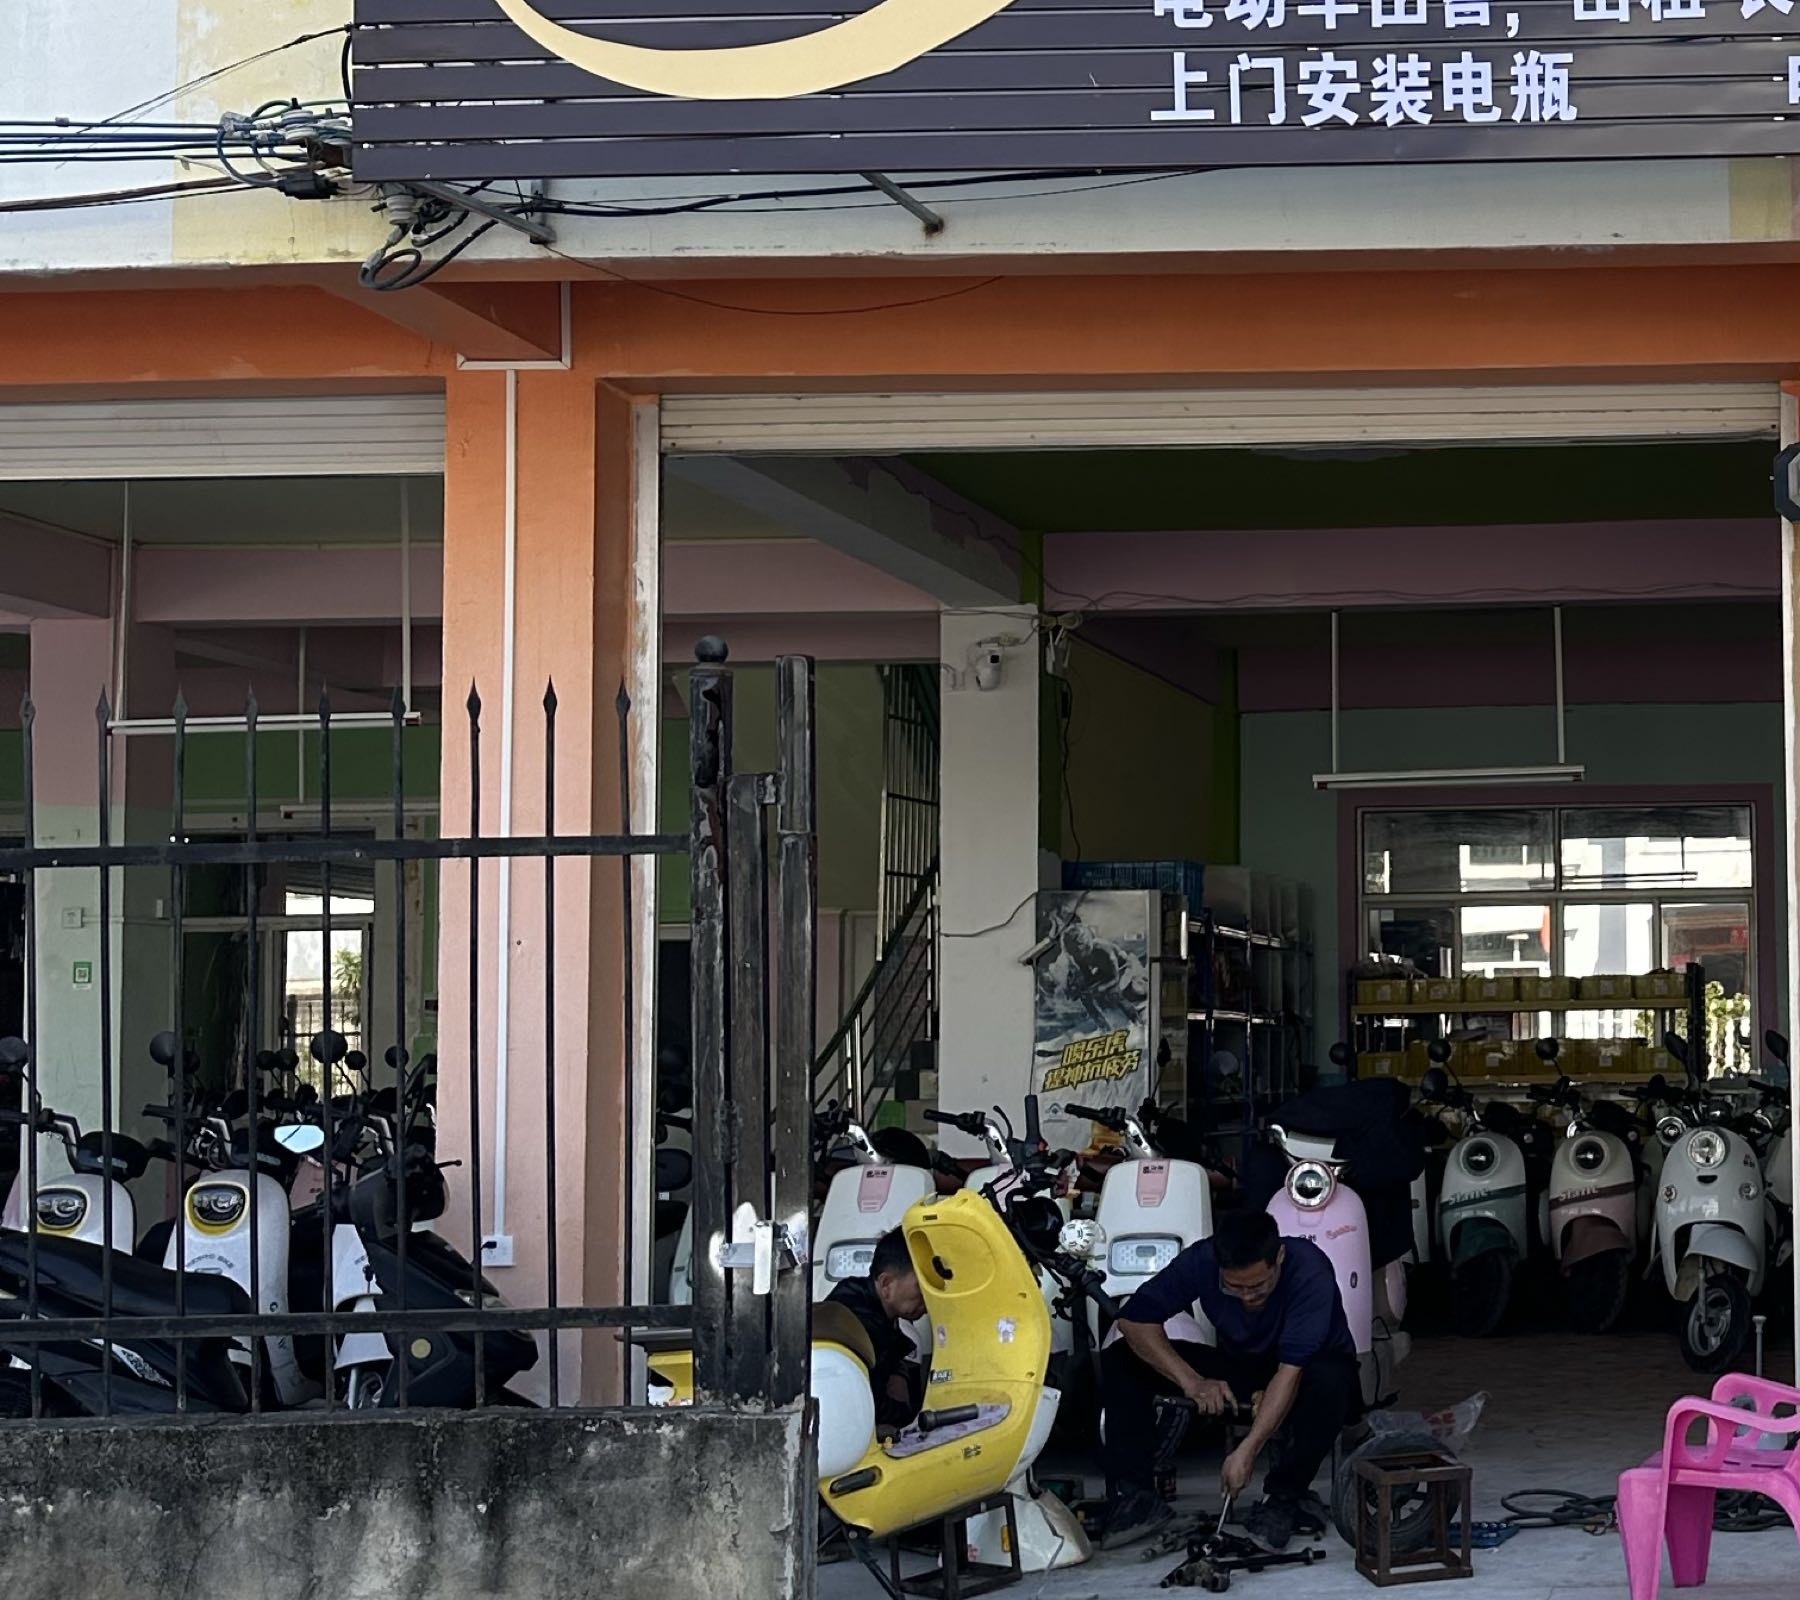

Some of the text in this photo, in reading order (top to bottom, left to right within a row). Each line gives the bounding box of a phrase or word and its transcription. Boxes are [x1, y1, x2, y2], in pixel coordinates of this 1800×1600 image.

[1150, 49, 1578, 128] 上门安装电瓶
